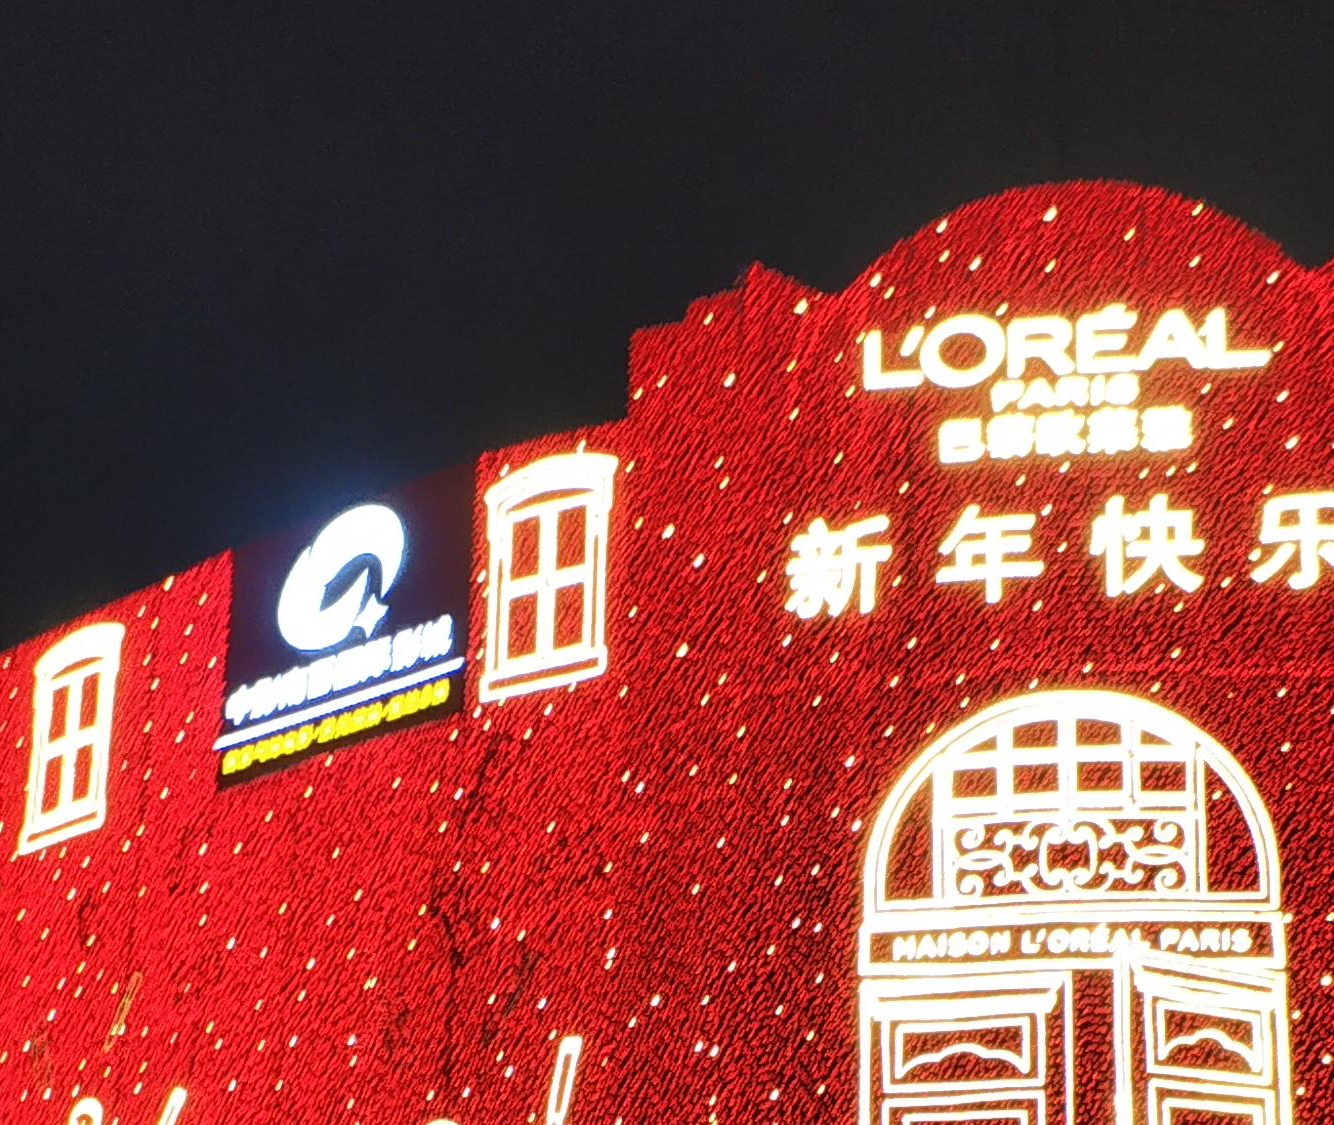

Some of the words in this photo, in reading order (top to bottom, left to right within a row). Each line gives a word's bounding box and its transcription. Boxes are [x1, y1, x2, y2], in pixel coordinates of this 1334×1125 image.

[863, 305, 1272, 390] L'ORÉAL
[990, 374, 1140, 412] PARIS
[892, 930, 1011, 961] MAISON
[1021, 923, 1151, 955] L'ORÉAL
[1160, 926, 1253, 953] PARIS
